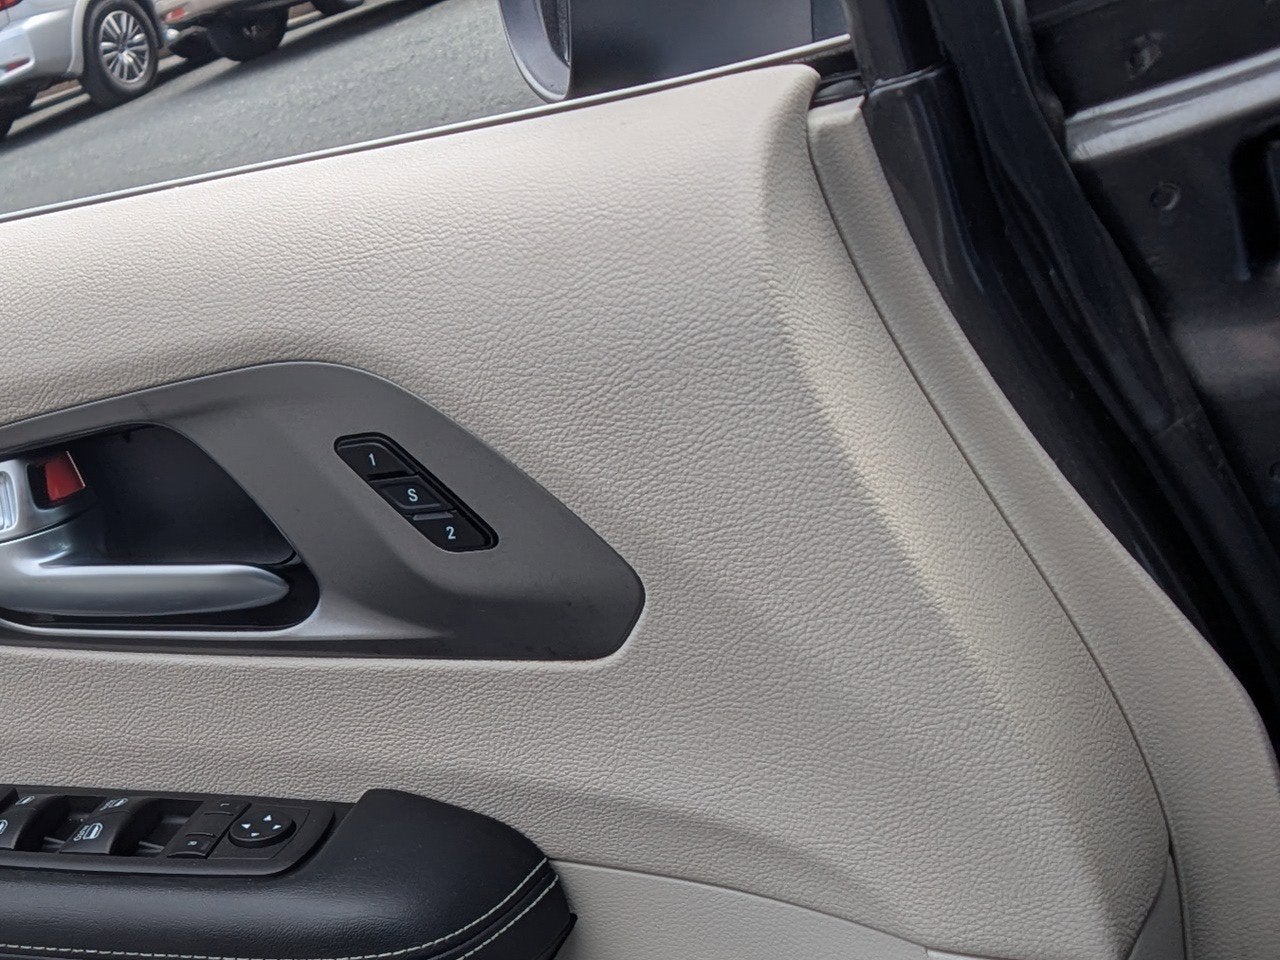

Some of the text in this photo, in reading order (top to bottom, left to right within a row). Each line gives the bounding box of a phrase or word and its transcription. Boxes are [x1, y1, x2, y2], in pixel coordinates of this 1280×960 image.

[369, 453, 376, 466] 1
[407, 488, 419, 502] S
[445, 526, 456, 540] 2
